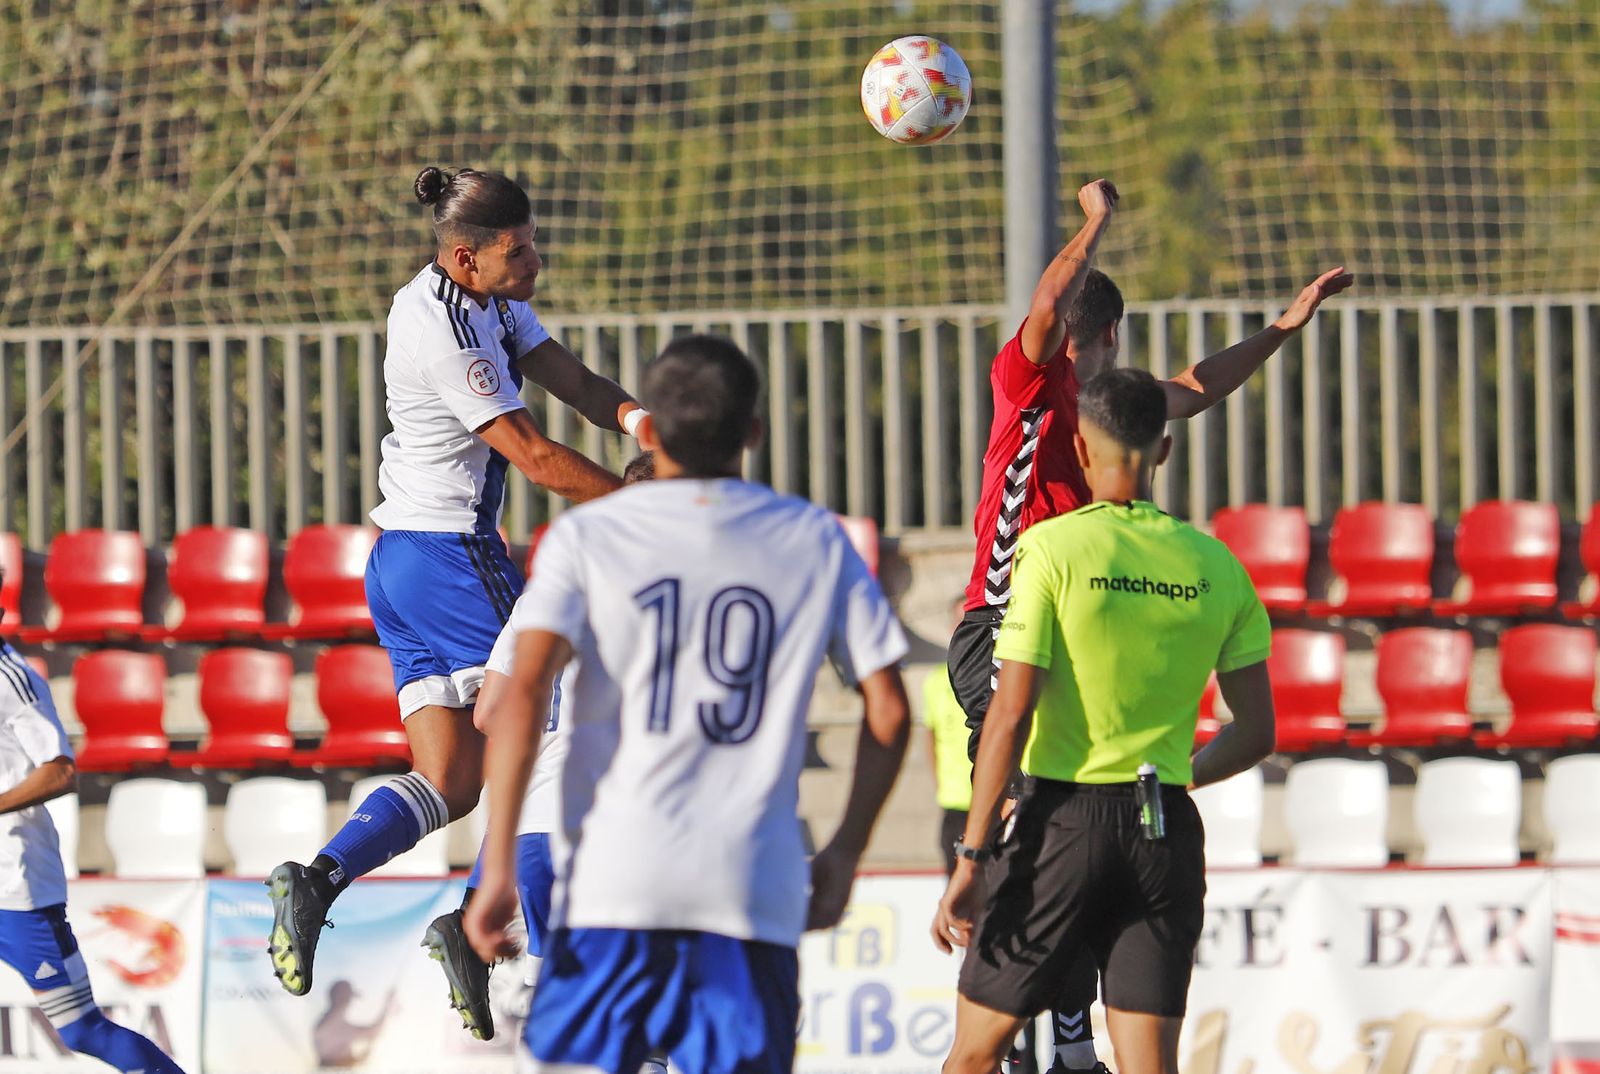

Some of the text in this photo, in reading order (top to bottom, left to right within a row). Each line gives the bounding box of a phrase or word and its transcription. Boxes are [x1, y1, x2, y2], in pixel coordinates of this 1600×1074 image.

[1090, 576, 1198, 601] matchapp
[633, 577, 776, 744] 19
[1357, 904, 1537, 969] BAR
